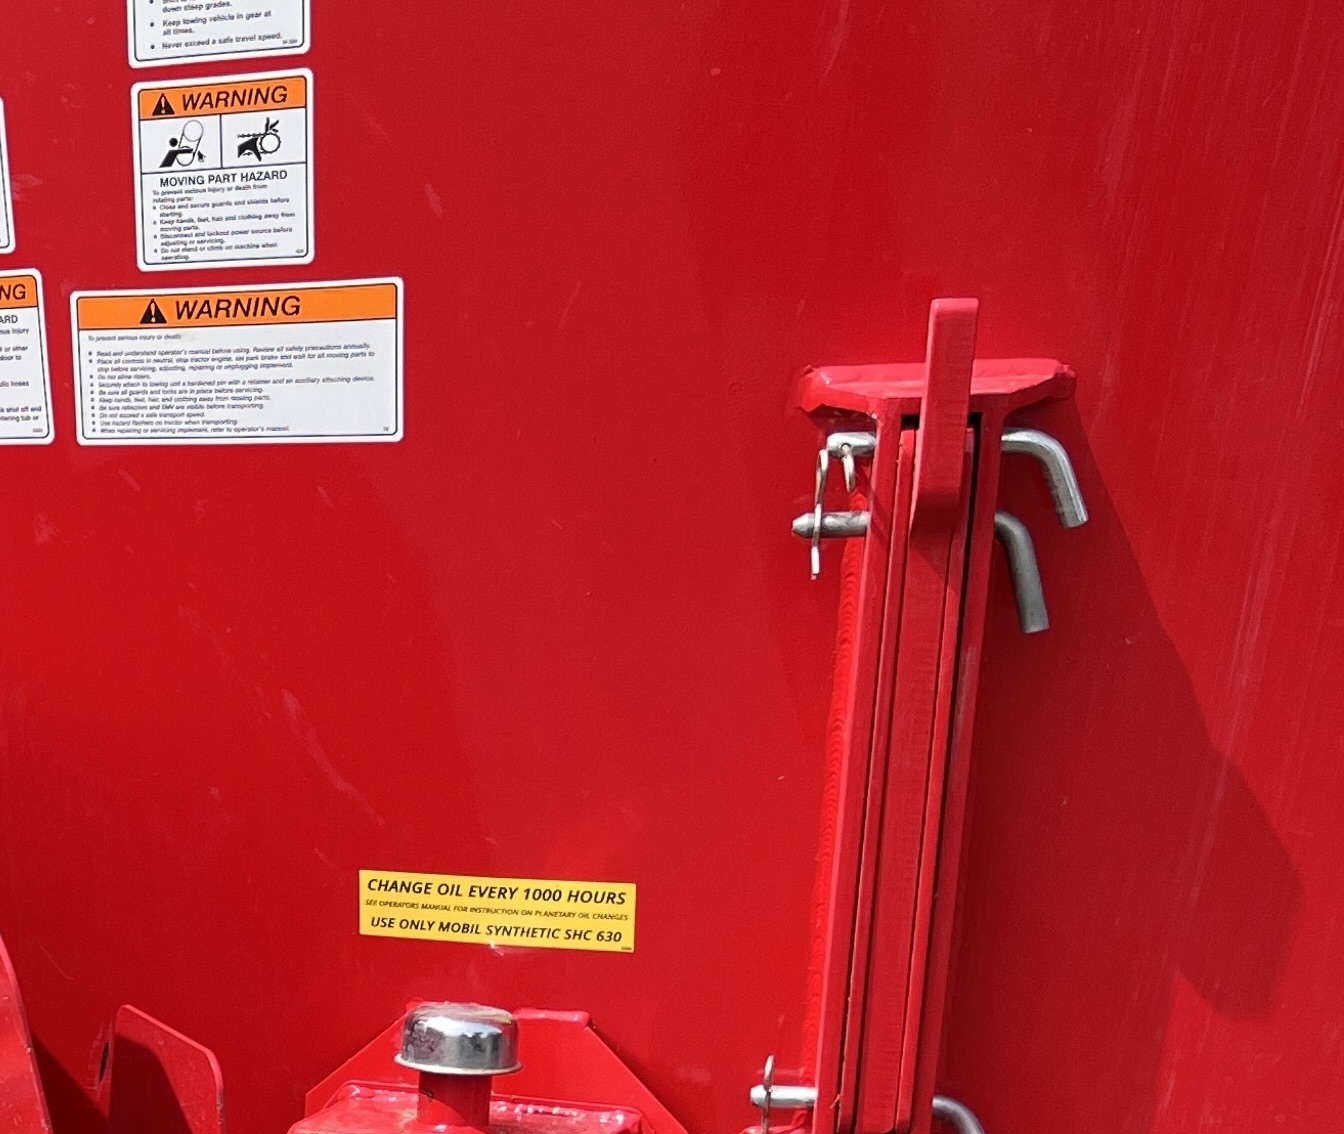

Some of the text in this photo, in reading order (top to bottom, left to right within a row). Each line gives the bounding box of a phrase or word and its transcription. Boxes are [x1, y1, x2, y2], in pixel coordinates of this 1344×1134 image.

[182, 86, 288, 111] WARNING
[159, 170, 287, 186] MOVING PART HAZARD
[175, 295, 301, 320] WARNING
[367, 879, 626, 904] CHANGE OIL EVERY 1000 HOURS
[370, 917, 622, 942] USE ONLY MOBIL SYNTHETIC SHC 630
